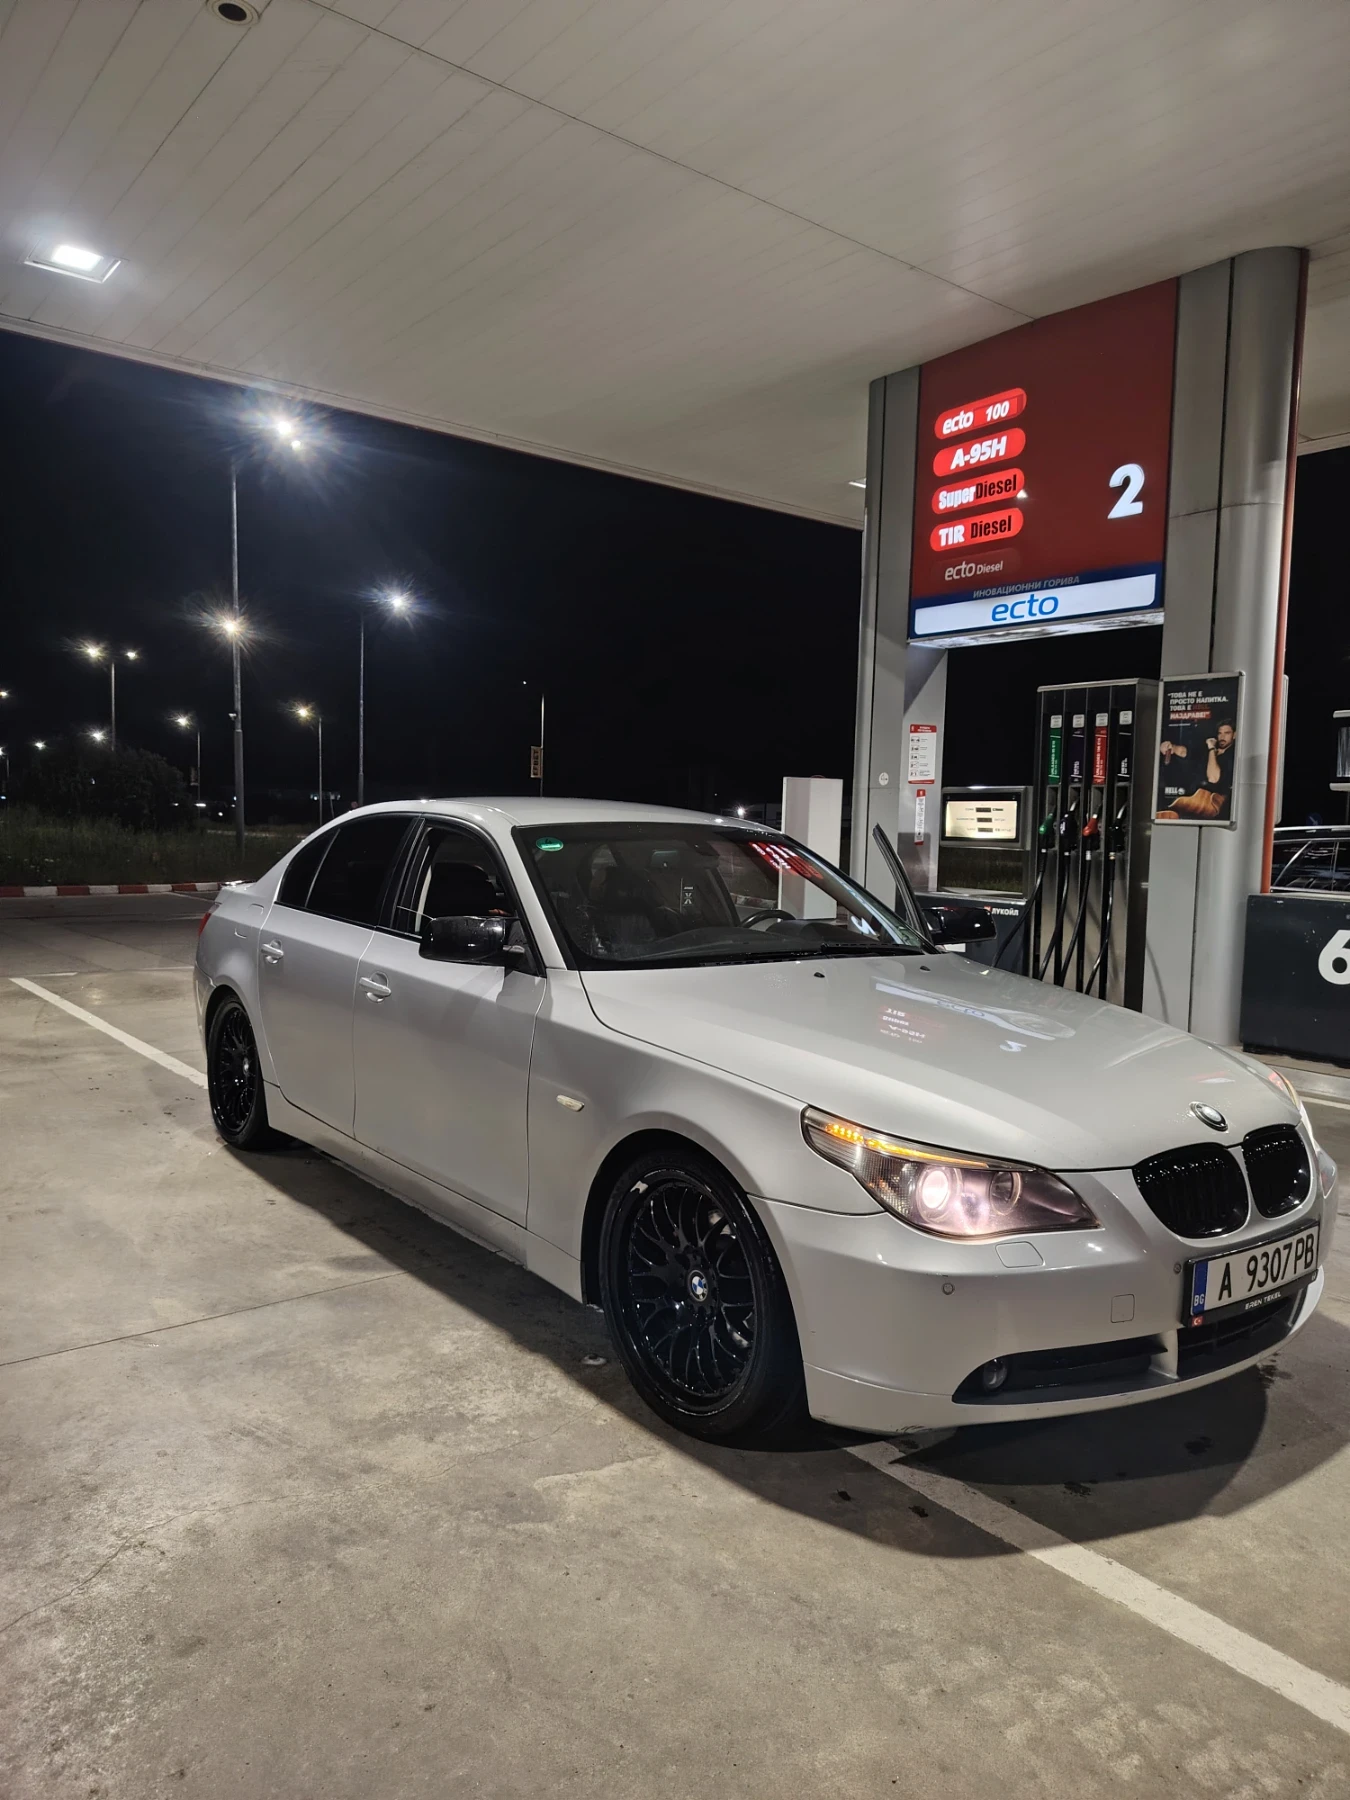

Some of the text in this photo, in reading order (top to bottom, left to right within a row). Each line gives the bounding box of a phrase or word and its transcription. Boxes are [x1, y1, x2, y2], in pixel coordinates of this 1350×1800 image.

[942, 400, 1010, 435] ecto 100
[950, 435, 1008, 470] A-95H
[1107, 463, 1145, 519] 2
[938, 515, 1012, 547] TIR Diesel
[944, 561, 1003, 581] ecto Diesel
[973, 576, 1080, 598] ИНОВАЦИОННИ ГОРИВА
[991, 594, 1059, 621] ecto
[1169, 704, 1186, 712] ТОВА
[991, 907, 1019, 916] ЛУКОЙЛ
[1317, 929, 1350, 985] 6
[1218, 1261, 1232, 1301] A
[1193, 1294, 1205, 1307] BG
[1245, 1291, 1282, 1310] EREN TEKEL
